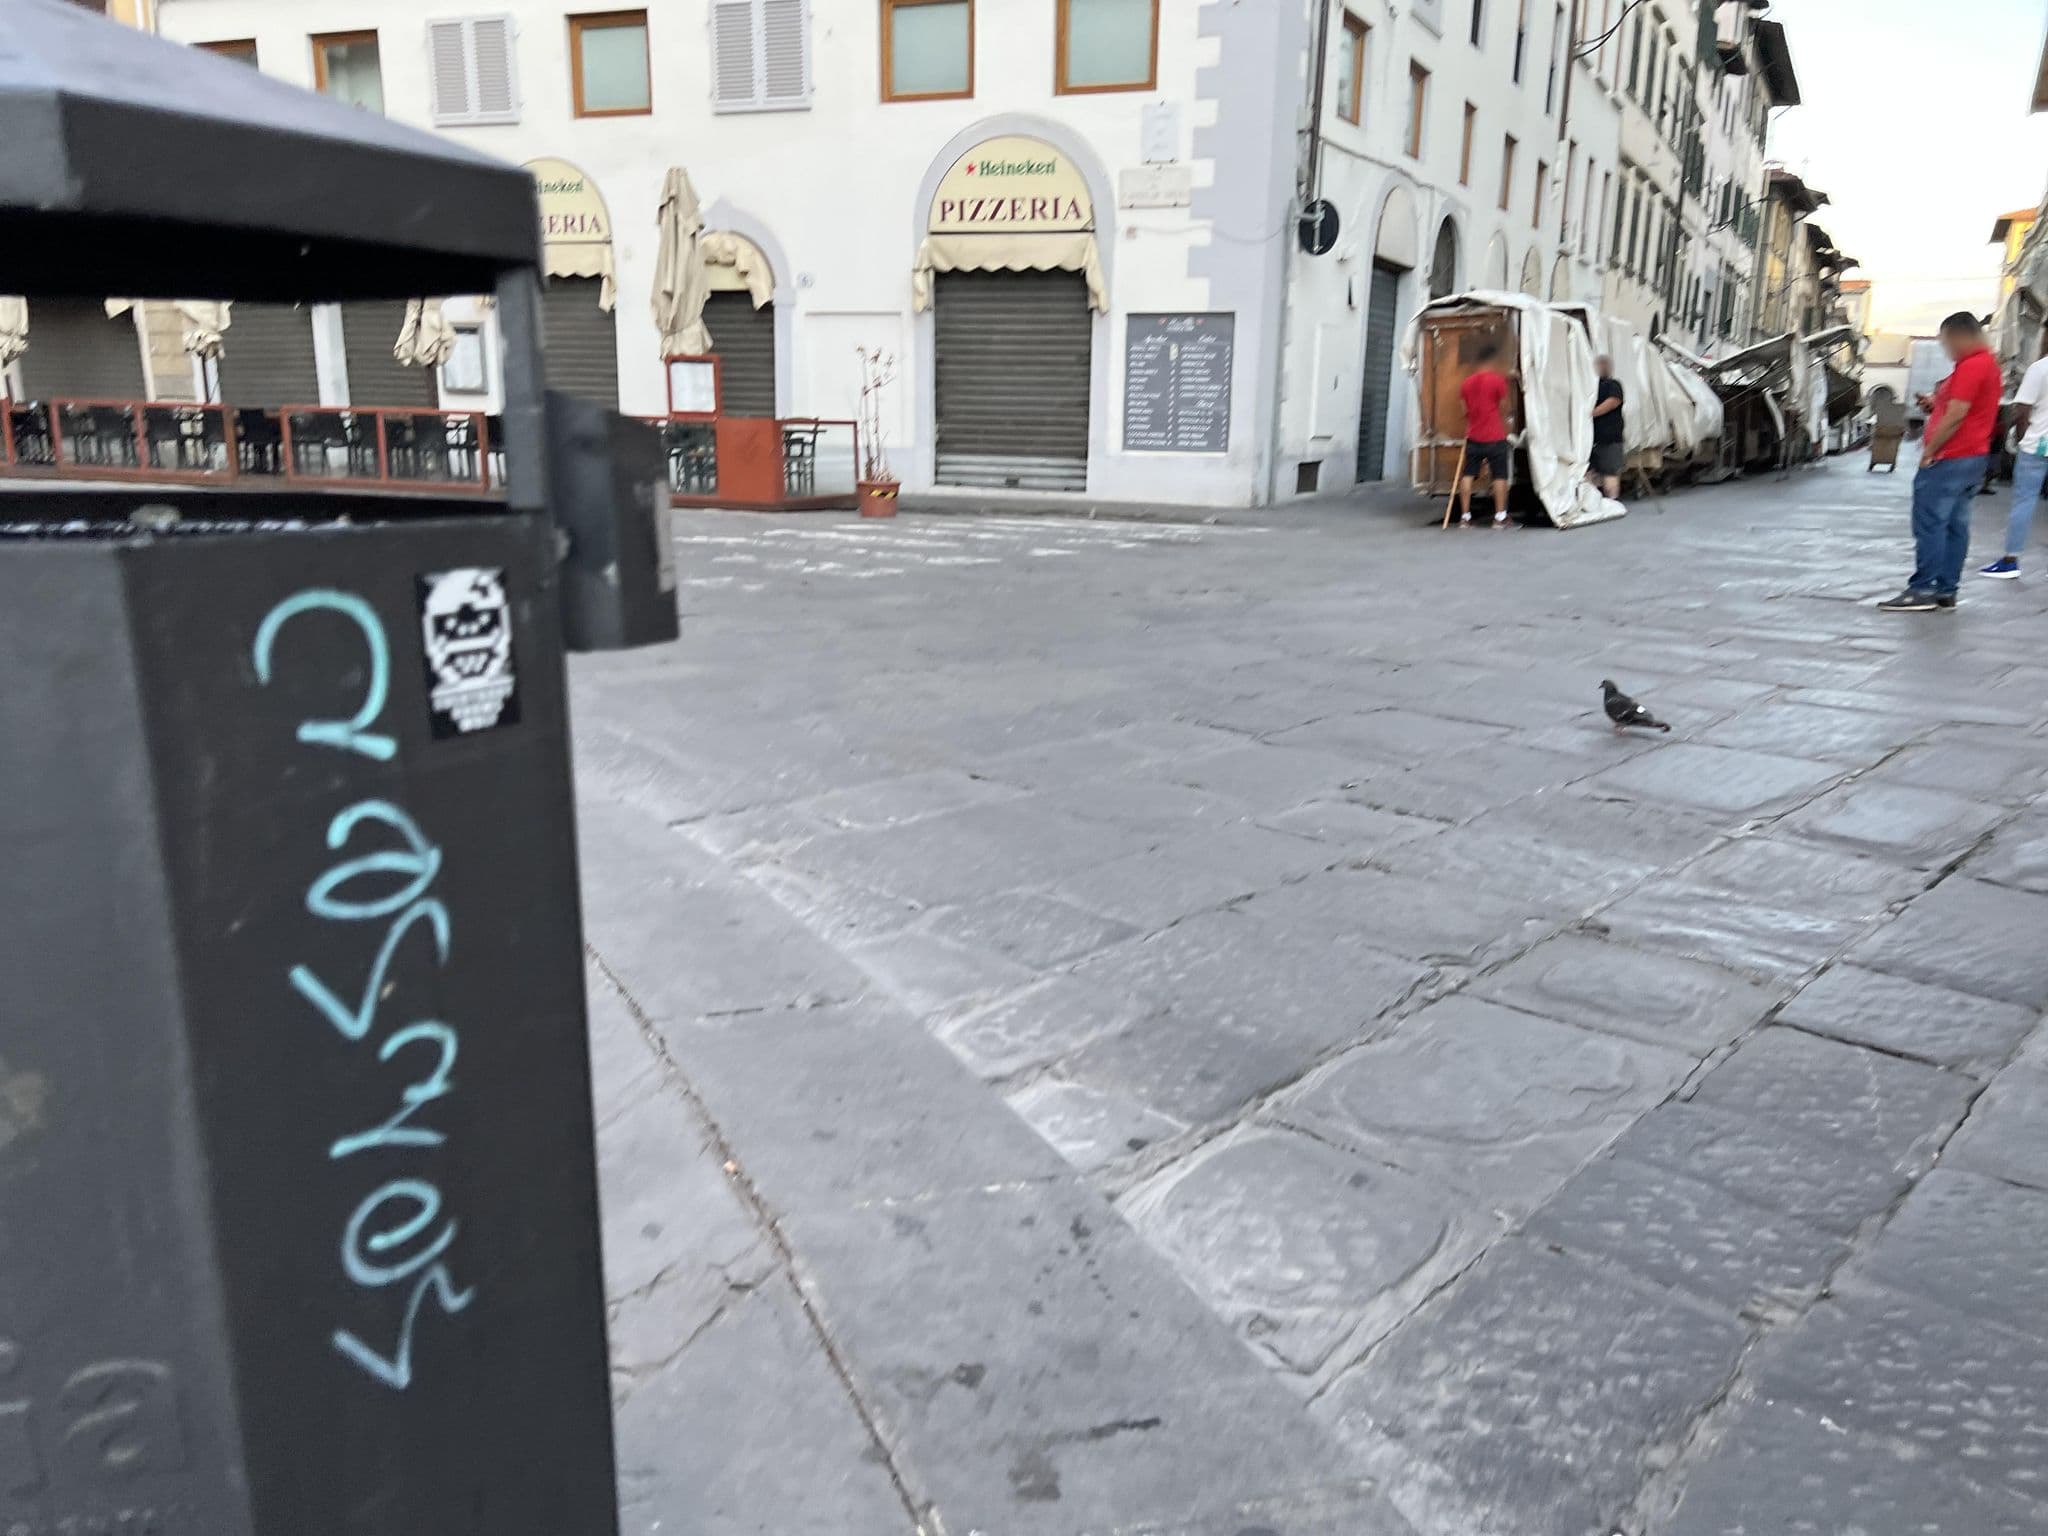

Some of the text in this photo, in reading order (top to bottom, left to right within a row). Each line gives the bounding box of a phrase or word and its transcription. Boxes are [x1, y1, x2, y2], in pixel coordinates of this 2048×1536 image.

[979, 157, 1057, 177] Heineken
[939, 196, 1083, 223] PIZZERIA
[541, 213, 602, 234] ERIA
